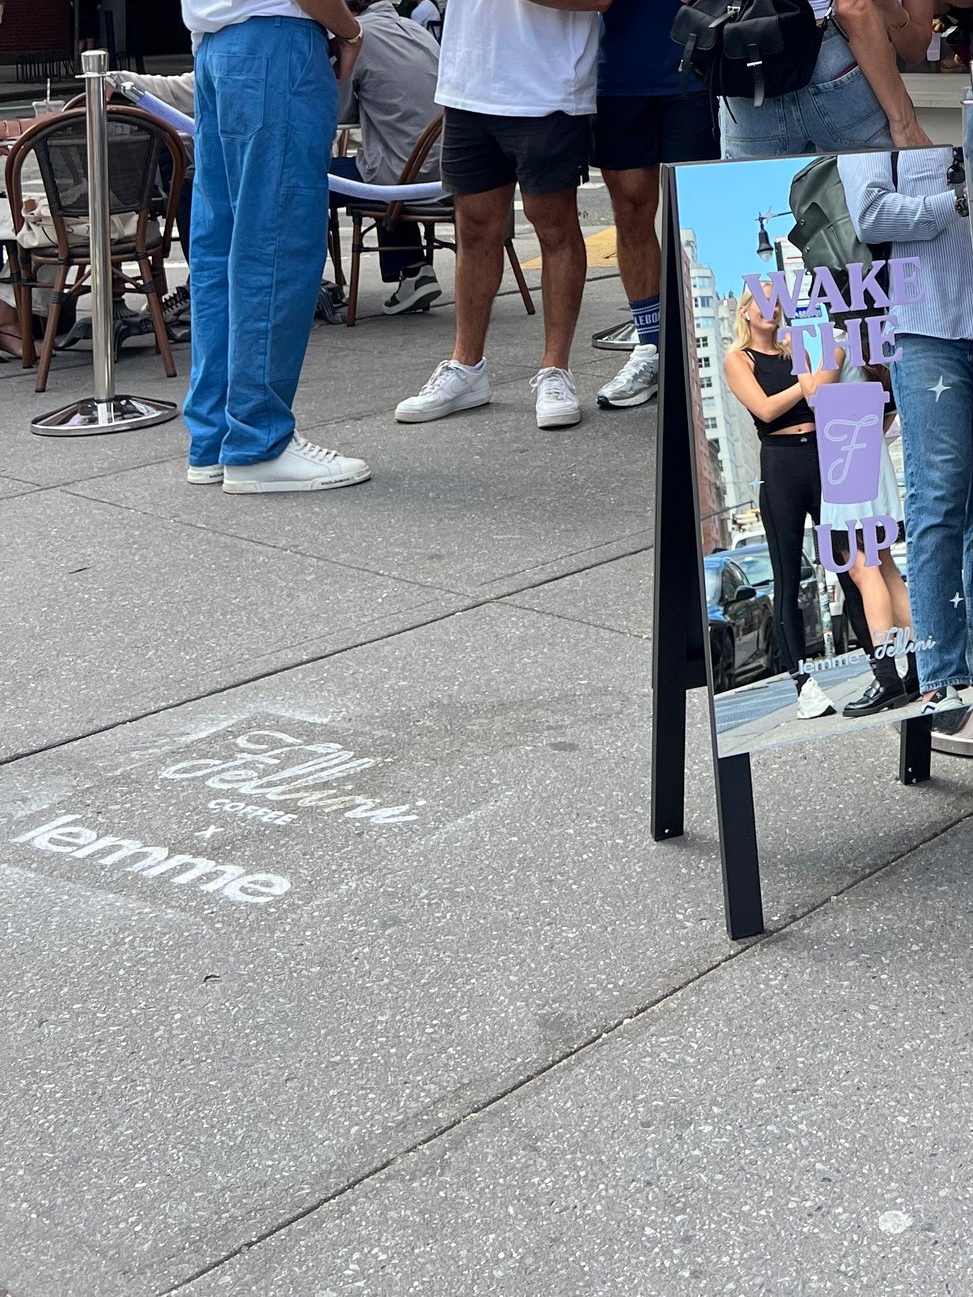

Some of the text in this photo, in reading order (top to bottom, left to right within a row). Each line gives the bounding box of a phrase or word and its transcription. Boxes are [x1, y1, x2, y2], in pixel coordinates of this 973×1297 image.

[743, 256, 926, 324] WAKE
[778, 314, 903, 376] THE
[815, 515, 899, 575] UP
[798, 653, 860, 675] lemme
[873, 626, 936, 660] Fellini
[160, 730, 428, 824] Fellini
[208, 798, 298, 826] COFFEE
[11, 813, 292, 904] lemme
